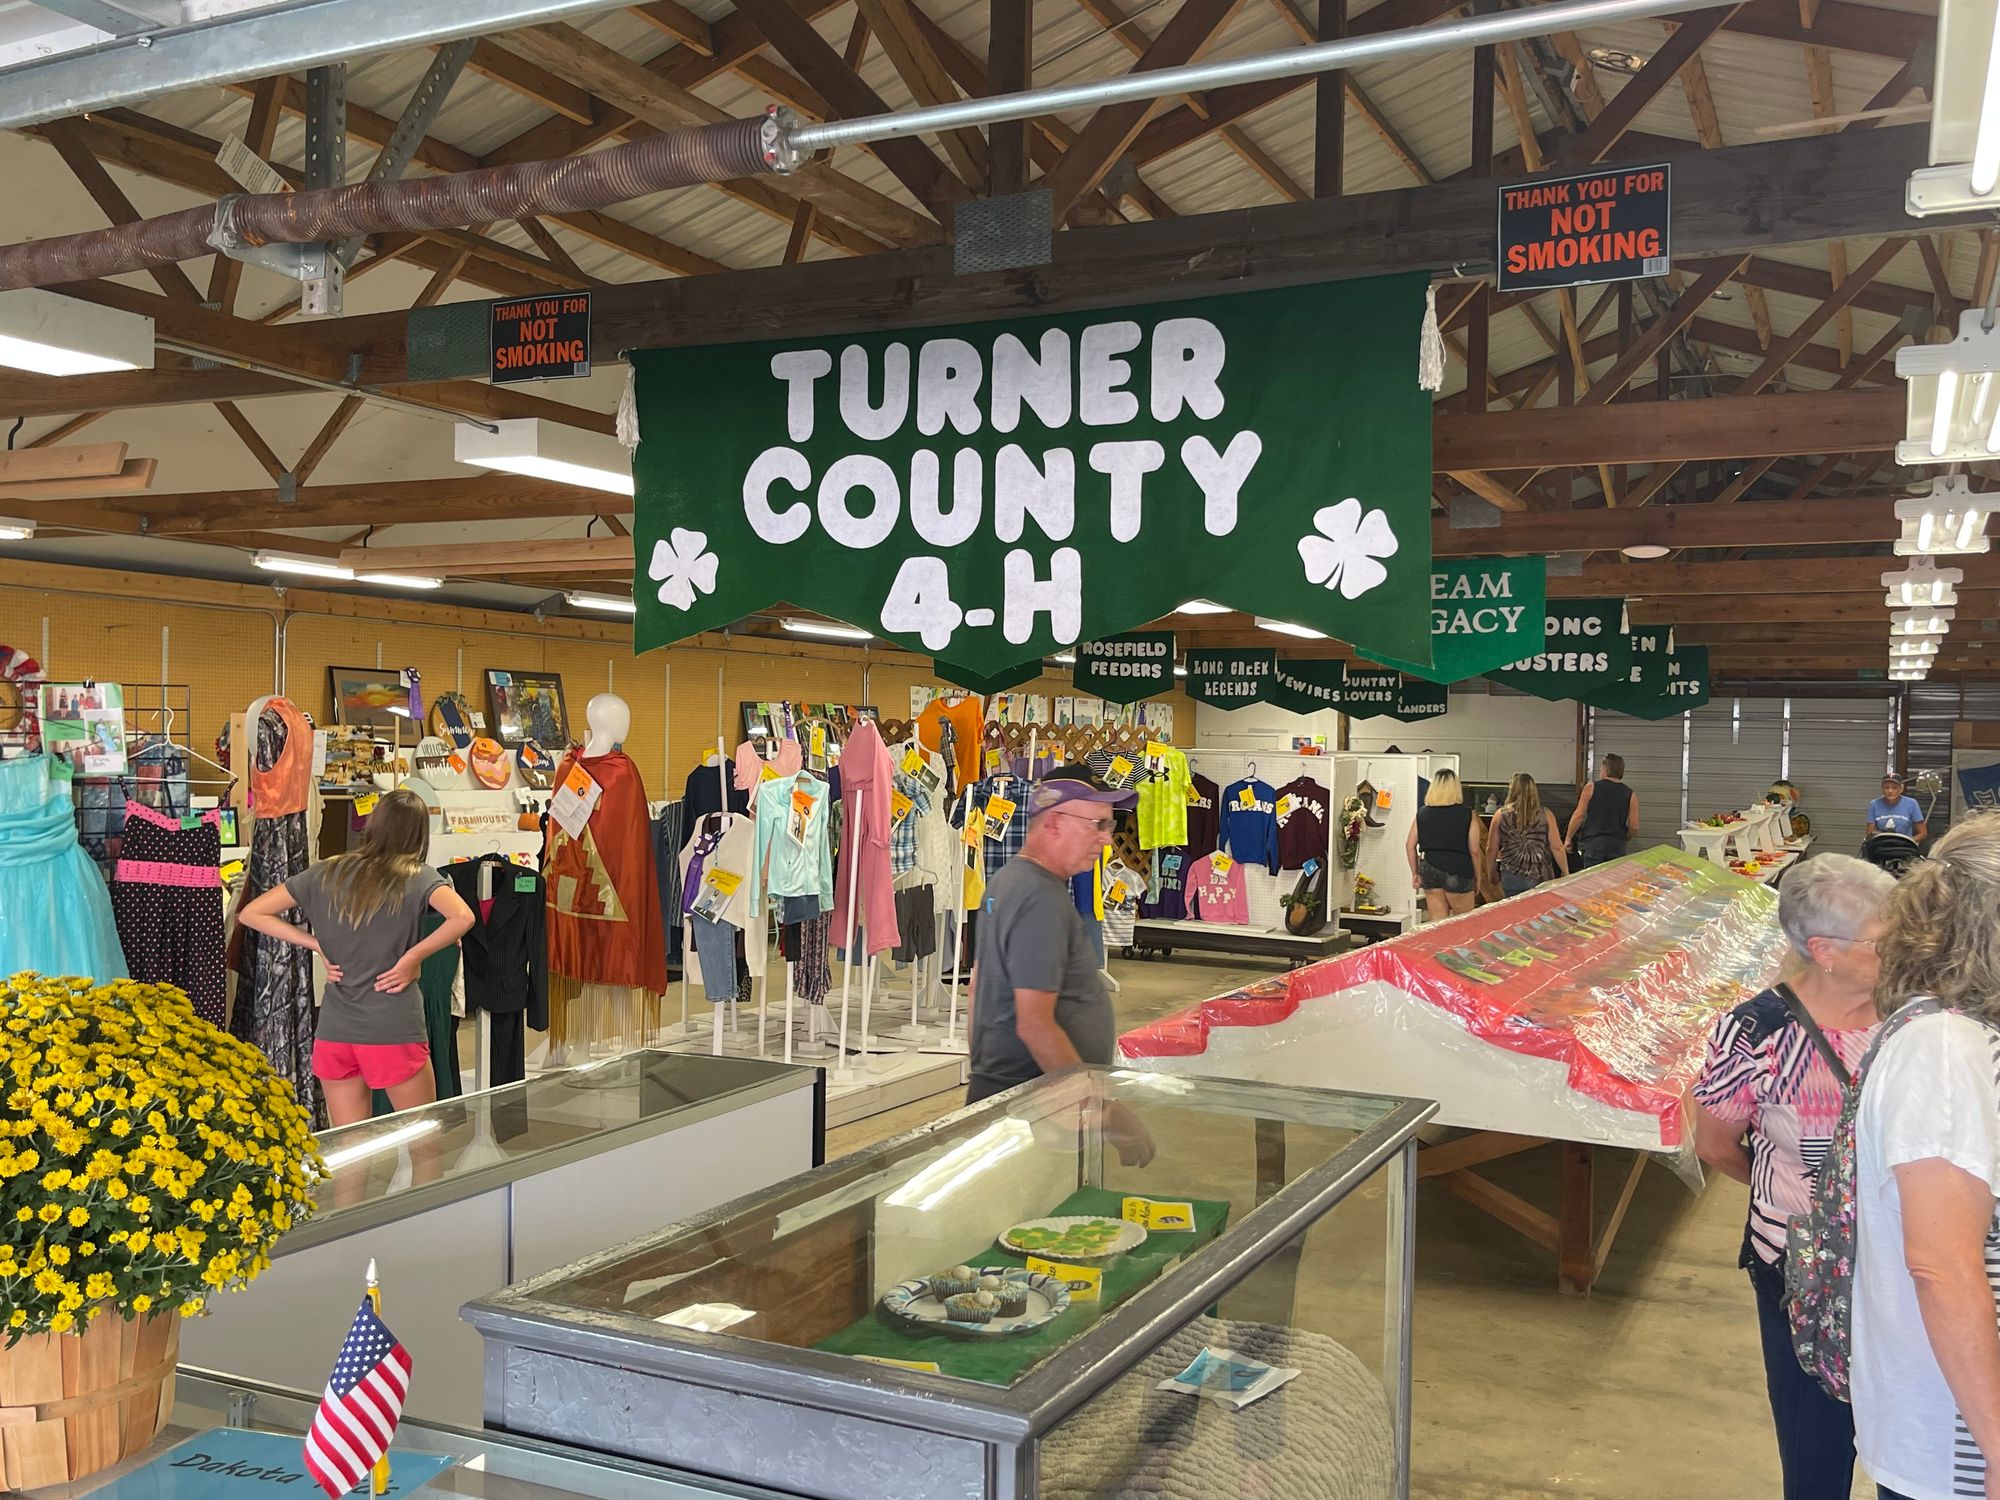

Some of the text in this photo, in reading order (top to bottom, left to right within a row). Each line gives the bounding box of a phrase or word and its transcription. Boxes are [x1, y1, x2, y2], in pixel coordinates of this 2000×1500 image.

[1505, 171, 1664, 211] THANK YOU FOR
[1551, 201, 1616, 236] NOT
[1507, 228, 1659, 273] SMOKING
[496, 298, 587, 321] THANK YOU FOR
[520, 318, 558, 342] NOT
[496, 340, 583, 369] SMOKING
[770, 317, 1226, 442] TURNER
[742, 430, 1262, 549] COUNTY
[880, 547, 1082, 651] 4-H
[1430, 572, 1513, 599] EAM
[1431, 606, 1525, 634] GACY
[1545, 616, 1602, 636] ONC
[1082, 641, 1166, 657] ROSEFIELD
[1091, 661, 1162, 678] FEEDERS
[1345, 677, 1396, 687] OUNTRY
[1276, 671, 1341, 702] VEWIRES
[1345, 691, 1392, 701] LOVERS
[1397, 703, 1446, 713] LANDERS
[451, 815, 508, 825] FARMHOUSE
[1198, 885, 1237, 904] HAPPY
[169, 1453, 304, 1484] Dakota
